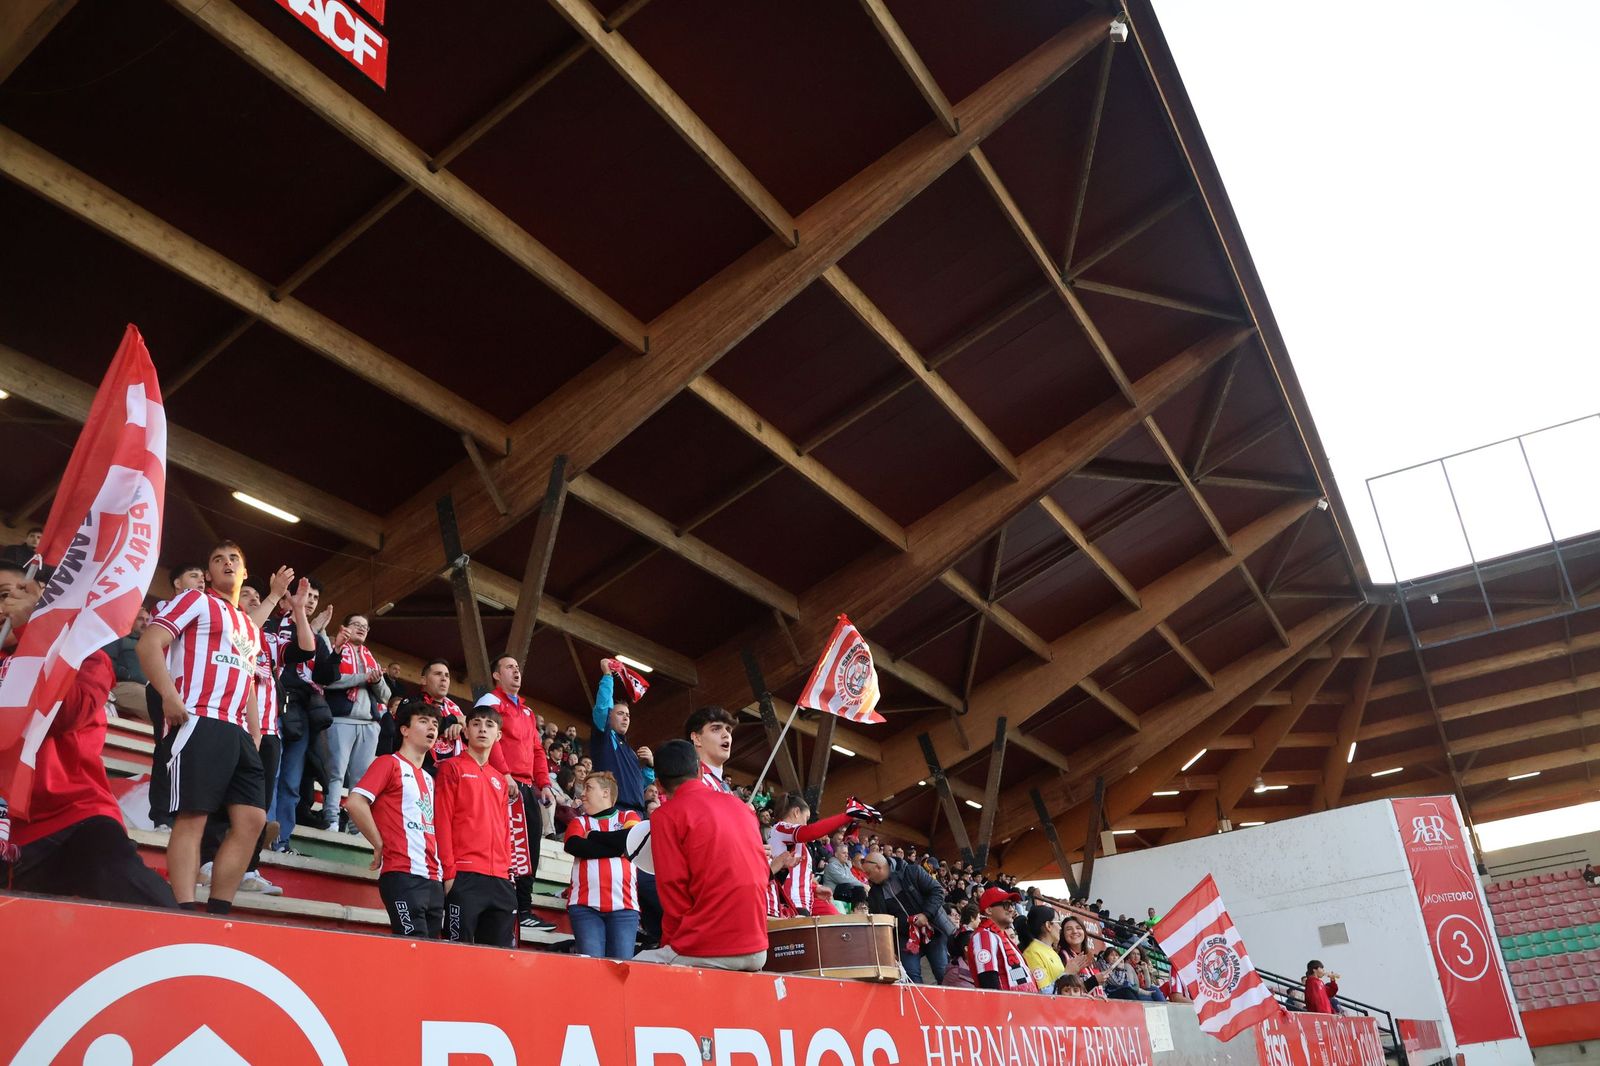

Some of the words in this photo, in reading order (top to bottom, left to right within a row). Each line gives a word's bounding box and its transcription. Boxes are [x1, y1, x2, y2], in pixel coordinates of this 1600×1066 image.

[215, 654, 240, 667] CAJA
[1424, 891, 1474, 905] MONTETORO
[394, 900, 415, 936] BKA
[449, 903, 461, 941] BKA
[1452, 930, 1475, 966] 3
[920, 1010, 1079, 1066] HERNÁNDEZ
[1082, 1025, 1148, 1066] BERNAL
